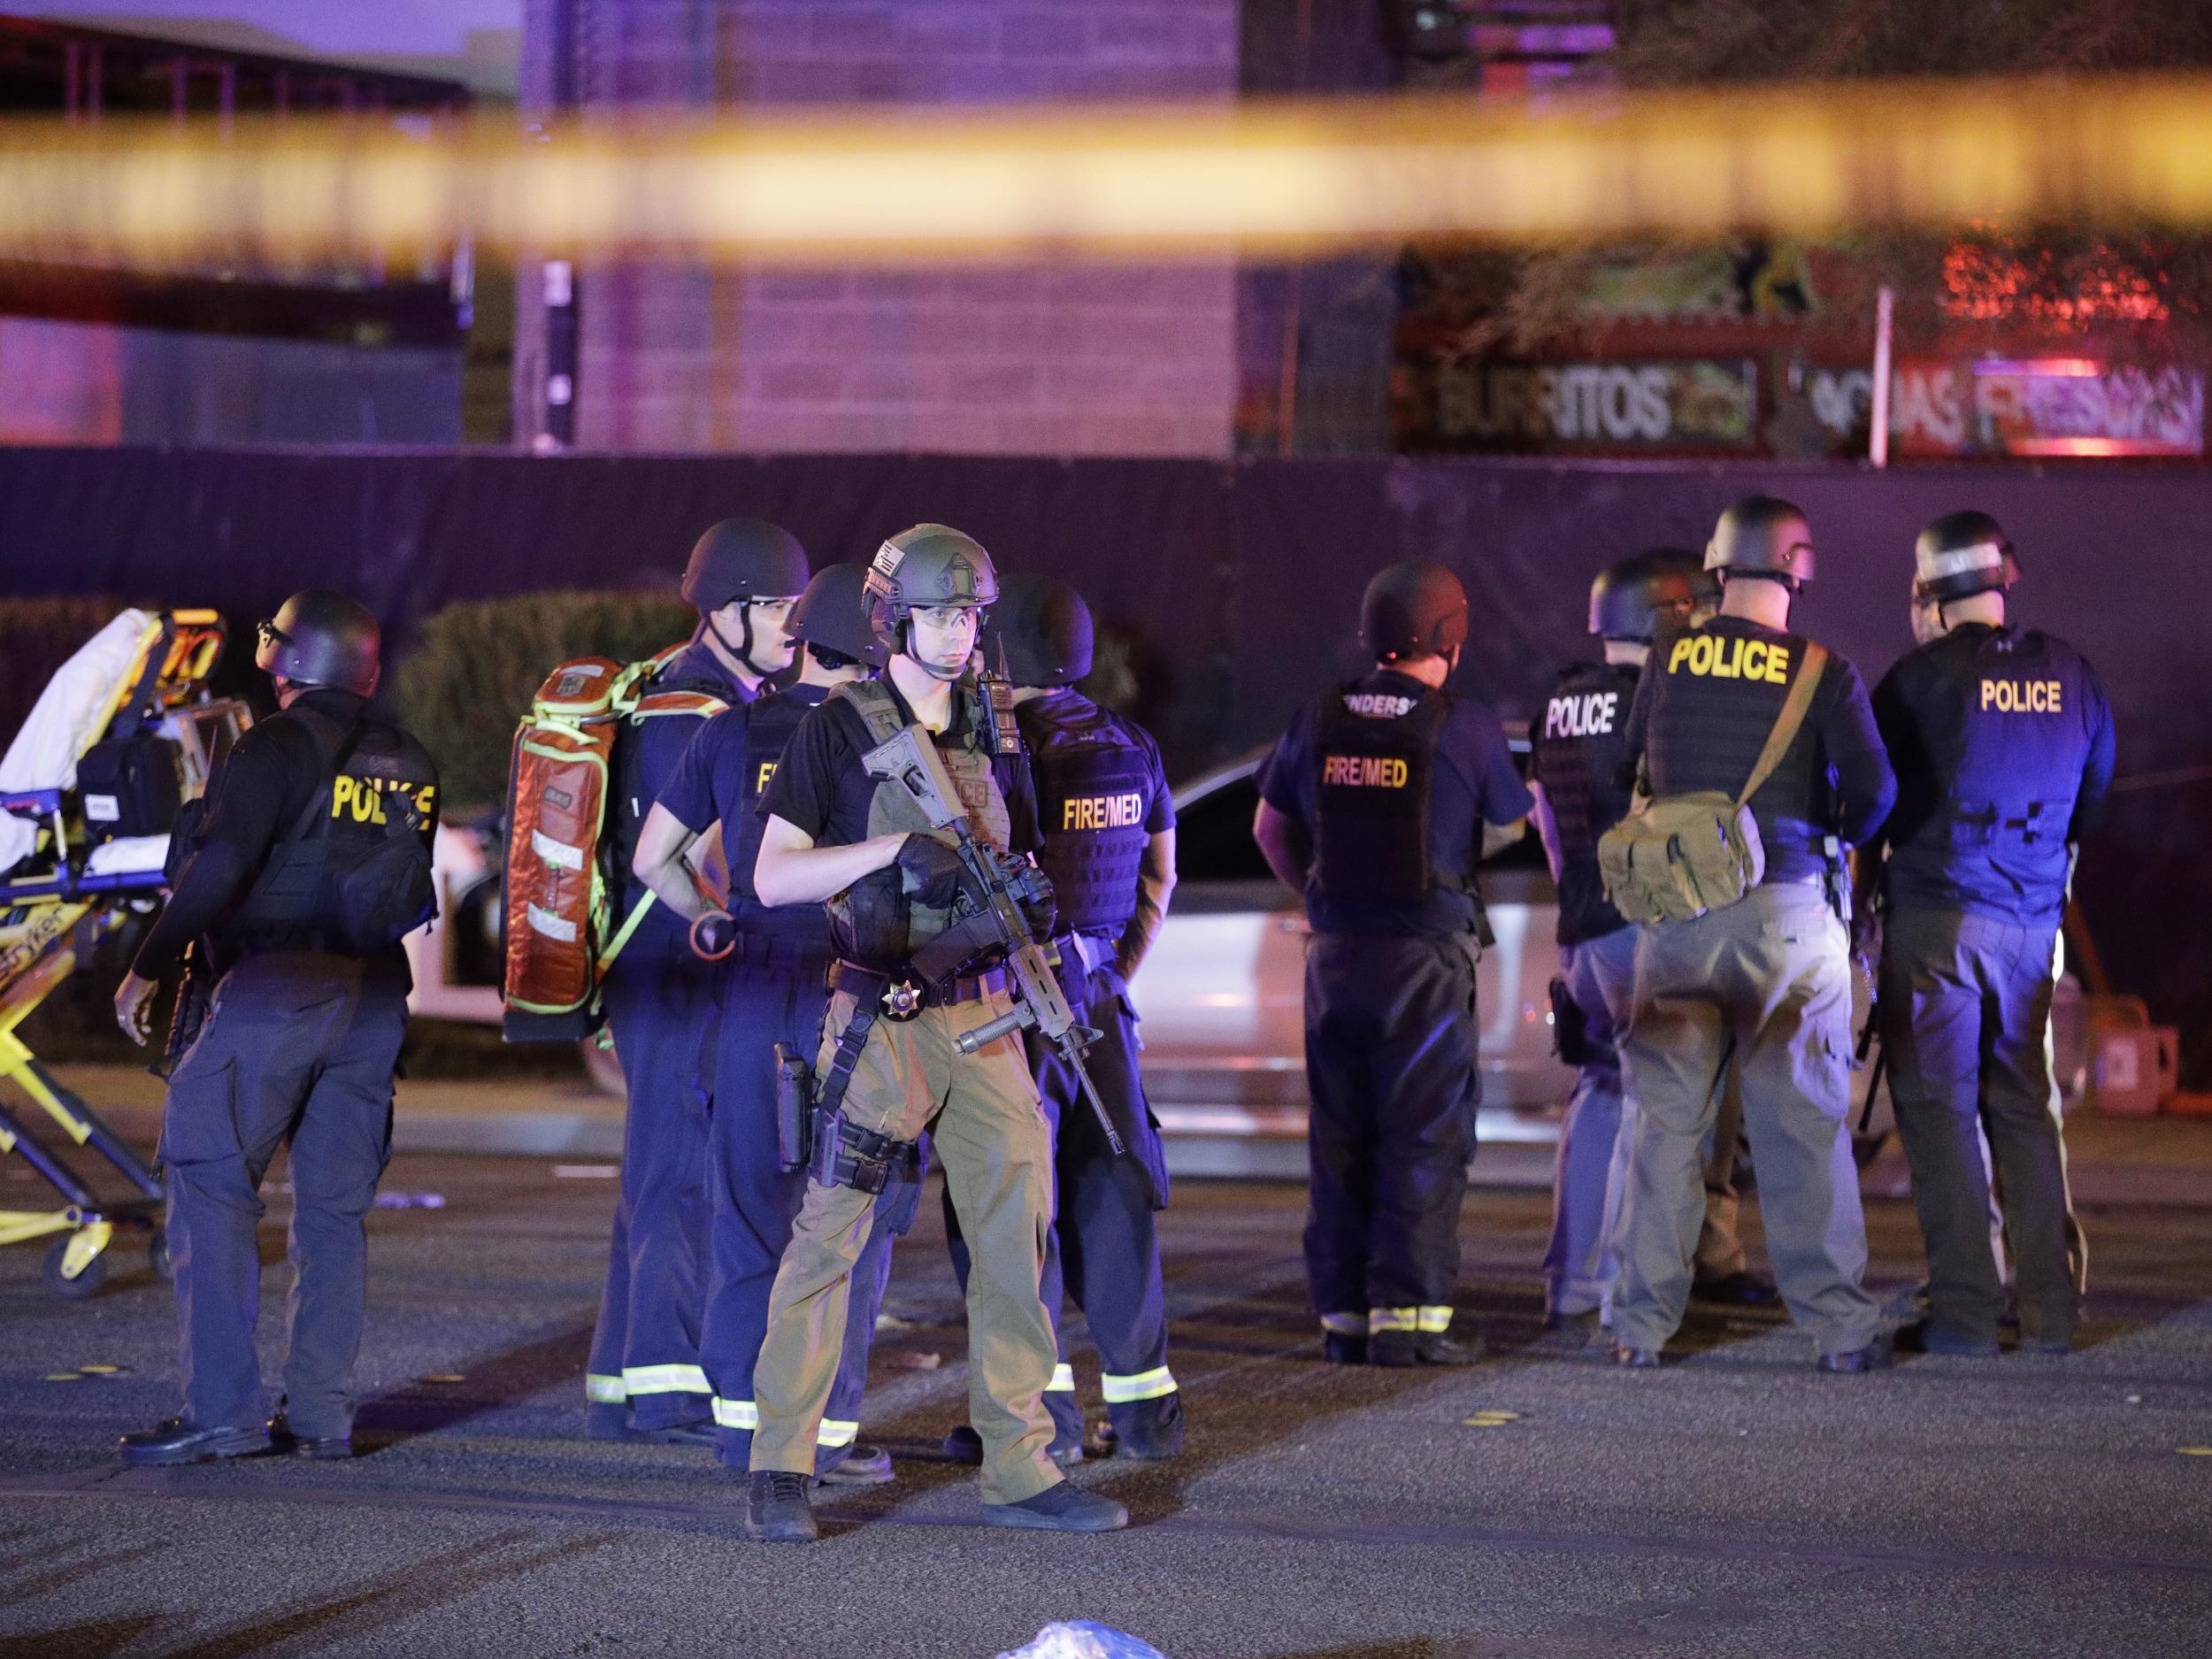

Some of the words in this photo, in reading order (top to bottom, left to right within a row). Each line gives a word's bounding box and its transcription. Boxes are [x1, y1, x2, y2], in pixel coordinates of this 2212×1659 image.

[1668, 634, 1789, 684] POLICE
[1343, 695, 1417, 716] NDERS
[1981, 680, 2062, 712] POLICE
[1546, 692, 1617, 738] POLICE
[1324, 757, 1408, 787] FIRE/MED
[1064, 794, 1141, 830] FIRE/MED
